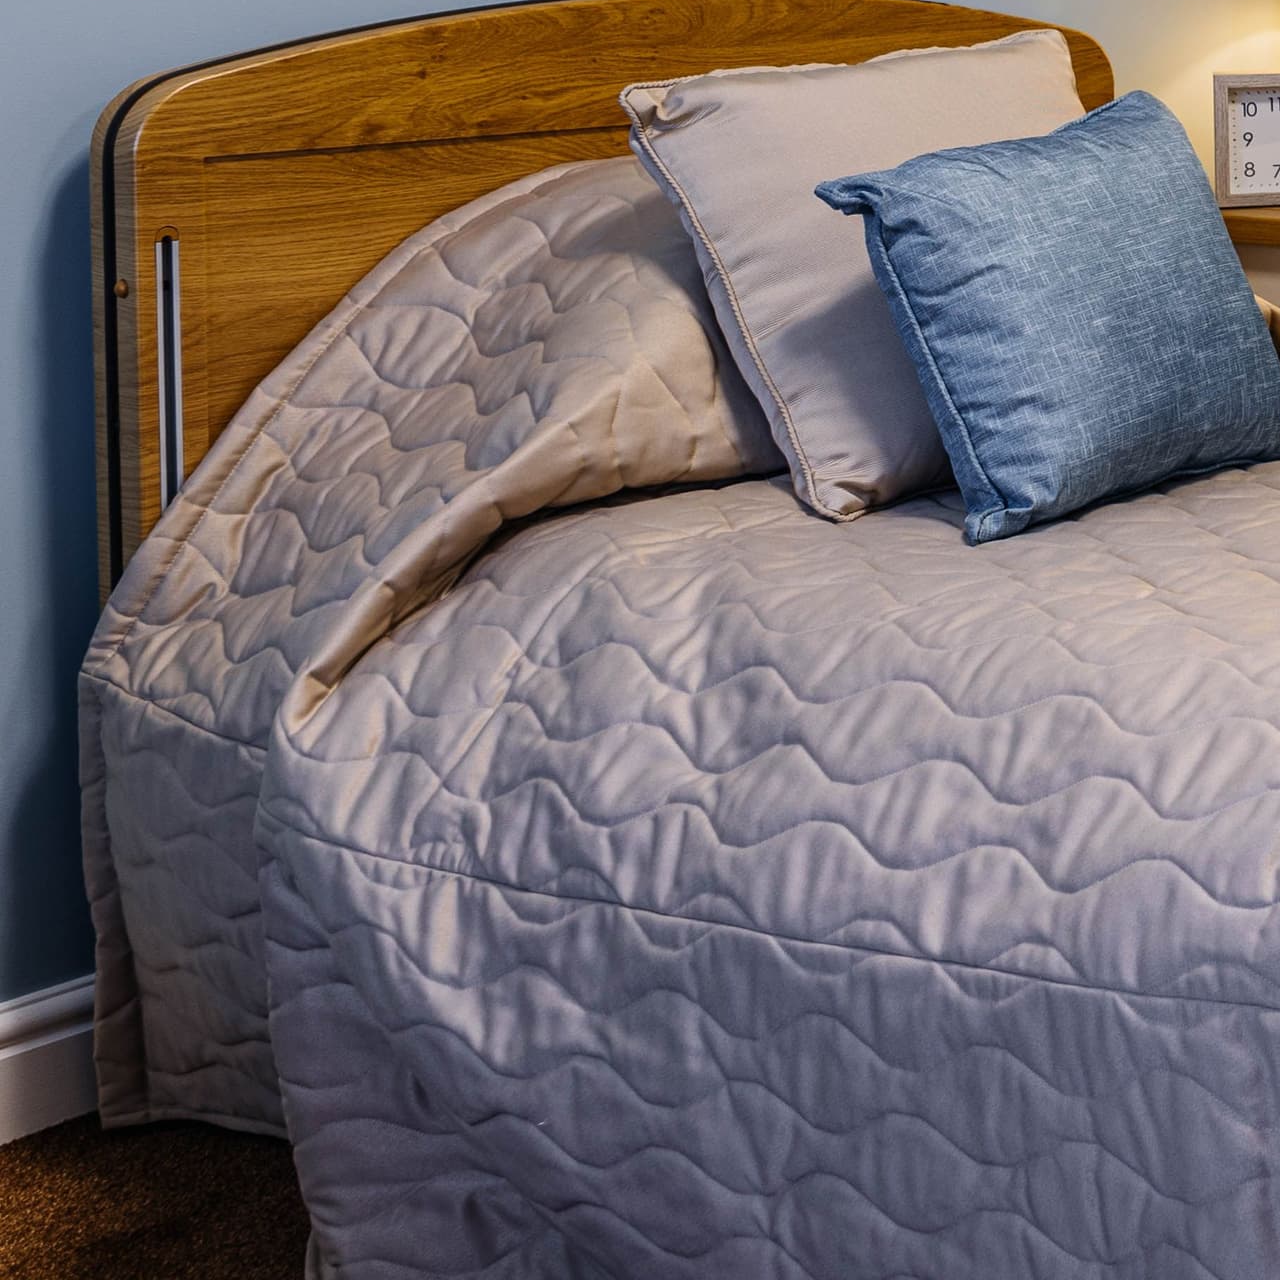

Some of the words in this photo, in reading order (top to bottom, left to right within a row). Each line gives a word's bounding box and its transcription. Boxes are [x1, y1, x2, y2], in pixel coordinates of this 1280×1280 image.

[1241, 102, 1257, 117] 10
[1243, 132, 1253, 147] 9
[1244, 162, 1256, 177] 8
